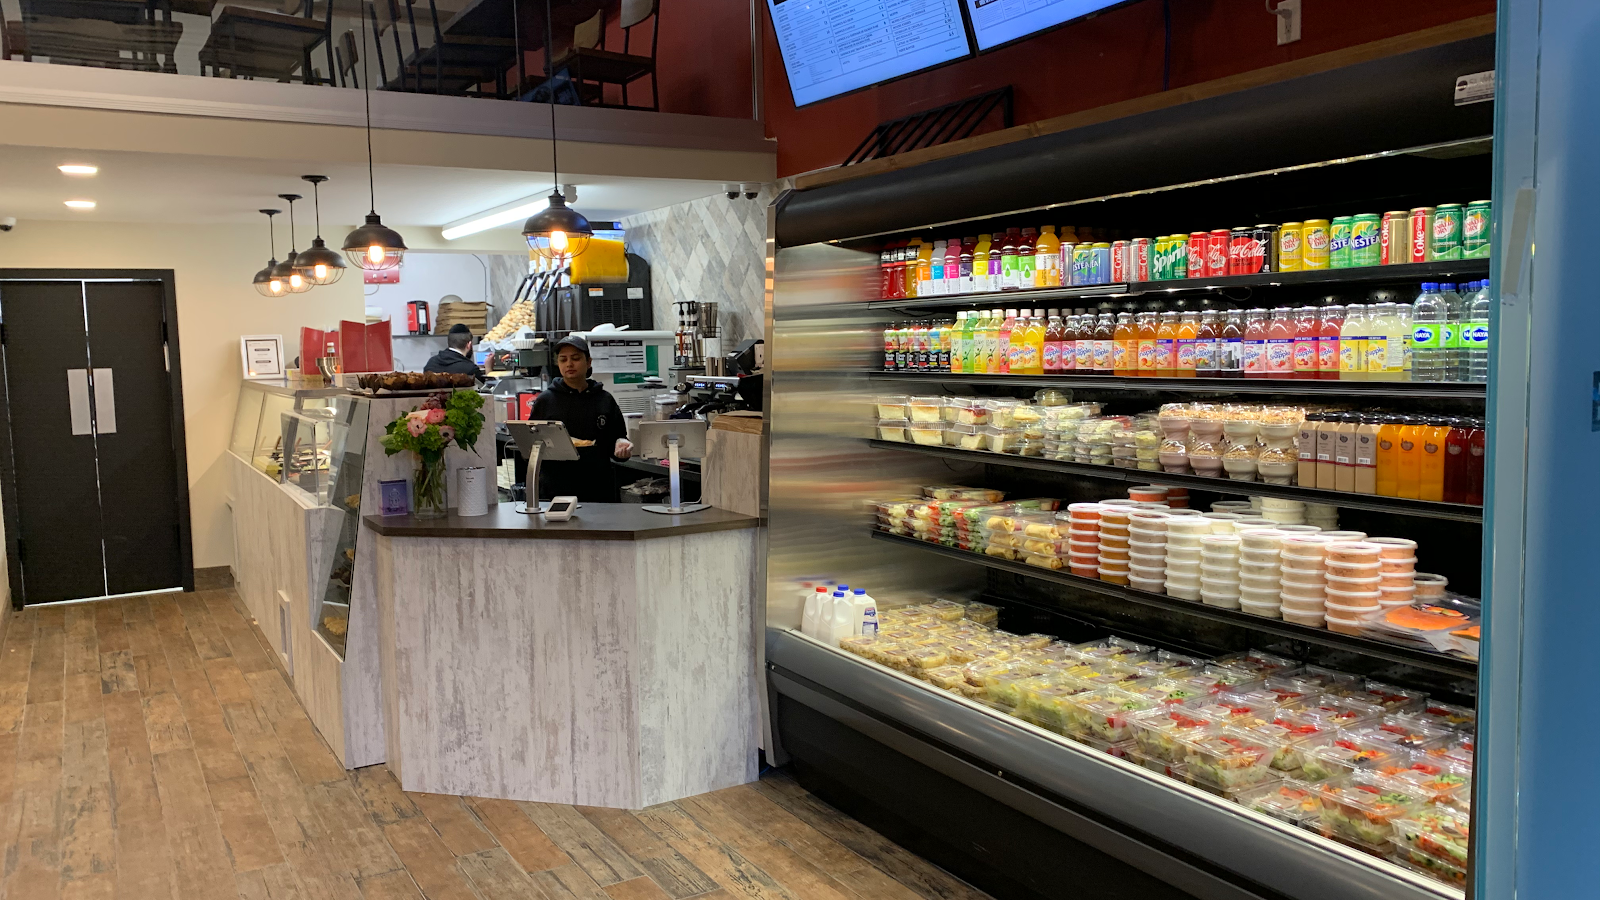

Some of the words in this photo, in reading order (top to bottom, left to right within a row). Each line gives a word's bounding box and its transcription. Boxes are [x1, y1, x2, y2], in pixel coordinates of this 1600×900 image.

[1330, 237, 1351, 250] ESTE
[1351, 235, 1381, 249] NESTEA
[1381, 221, 1389, 246] Coke
[1413, 231, 1425, 257] Coke
[1114, 248, 1122, 268] Coke
[1139, 245, 1147, 266] Coke
